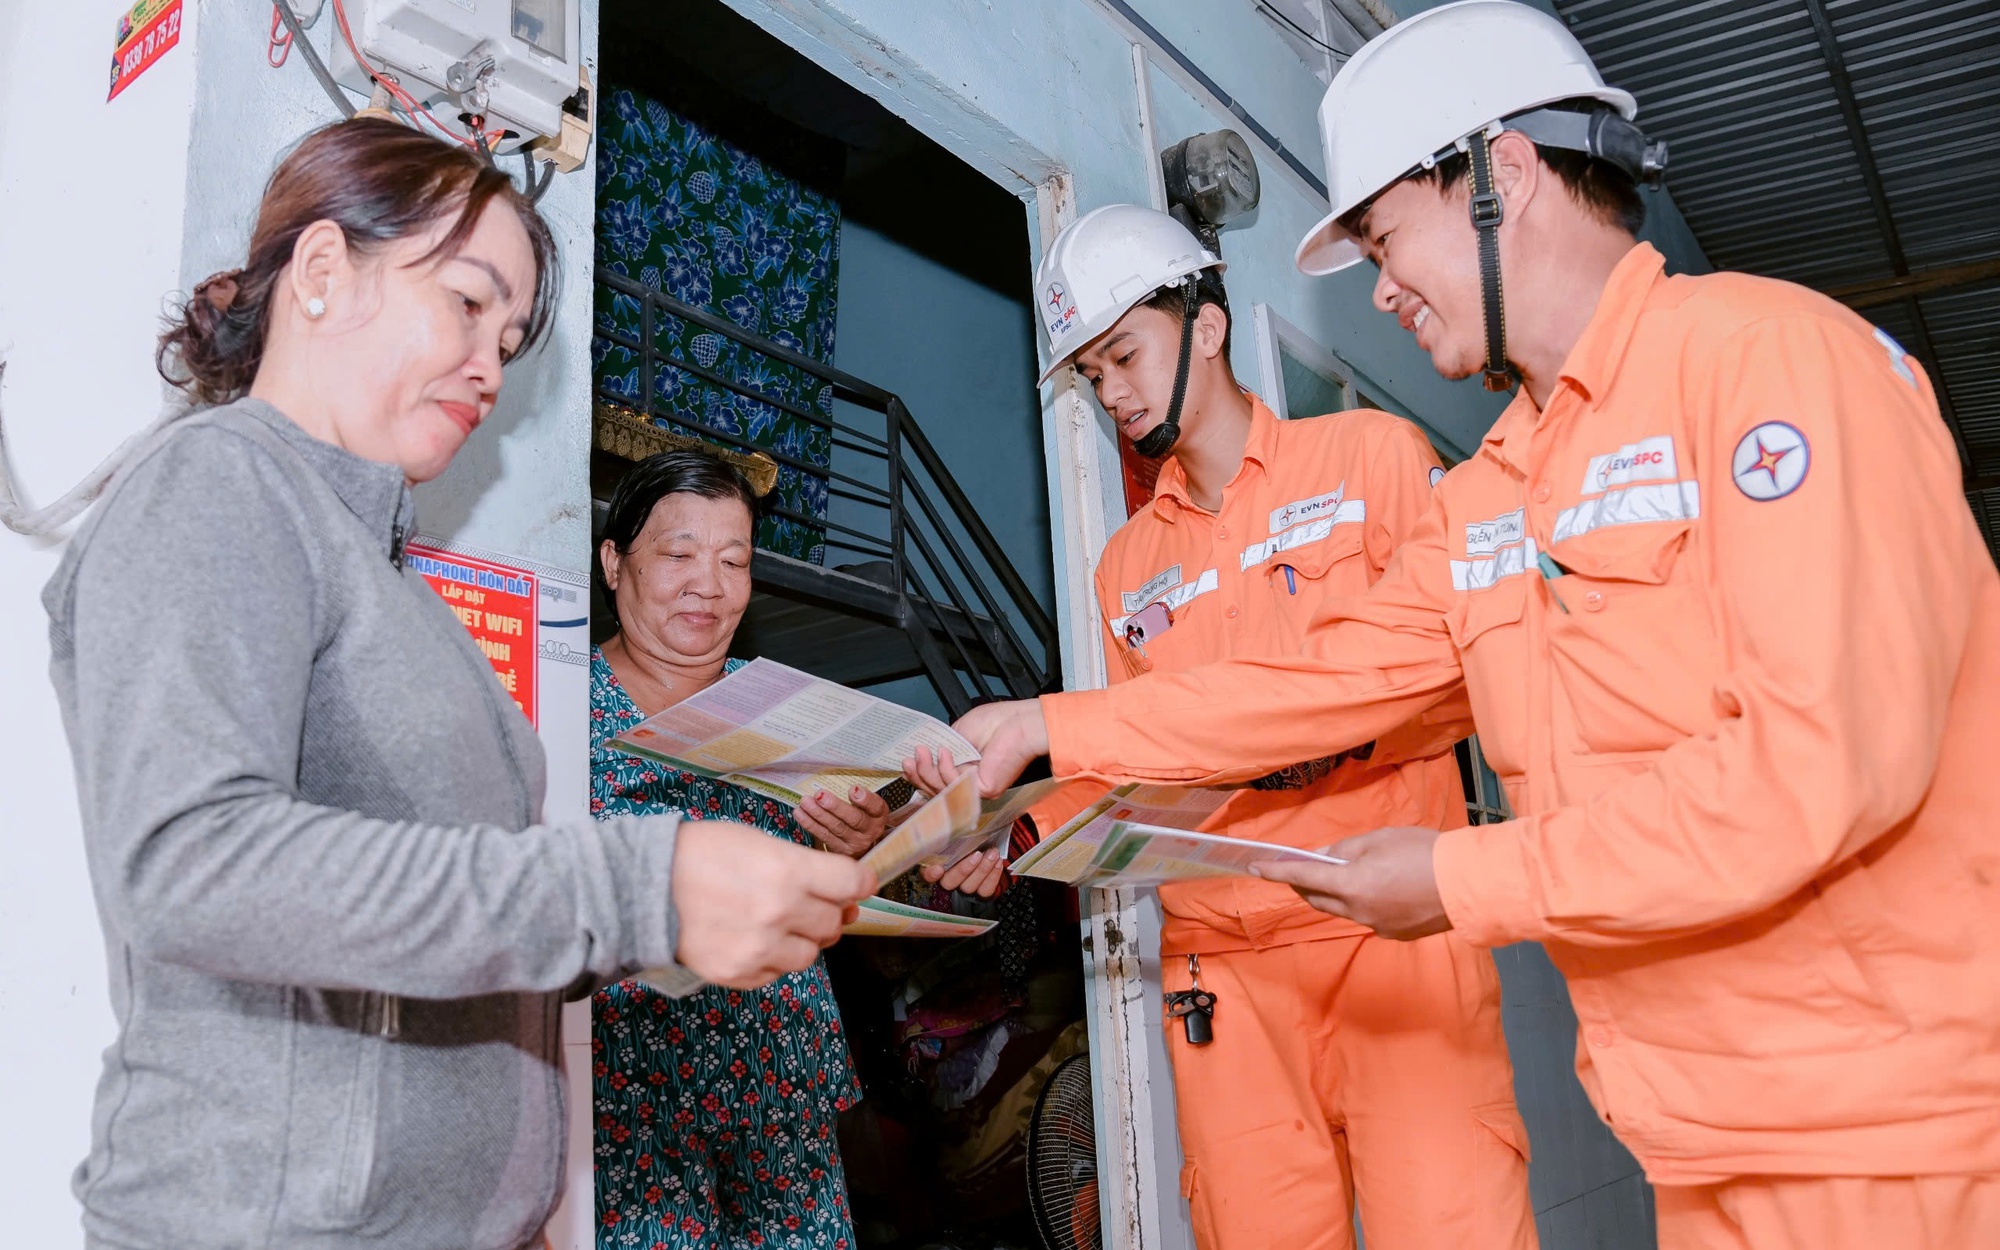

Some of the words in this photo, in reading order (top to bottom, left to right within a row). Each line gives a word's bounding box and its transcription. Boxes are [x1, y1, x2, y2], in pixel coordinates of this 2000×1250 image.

[156, 19, 167, 48] 75
[167, 8, 180, 38] 22
[1050, 317, 1064, 333] EVN
[1064, 306, 1076, 321] SPC
[405, 555, 477, 585] INAPHONE
[477, 569, 505, 592] HÒN
[450, 605, 483, 629] NET
[485, 612, 522, 636] WIFI
